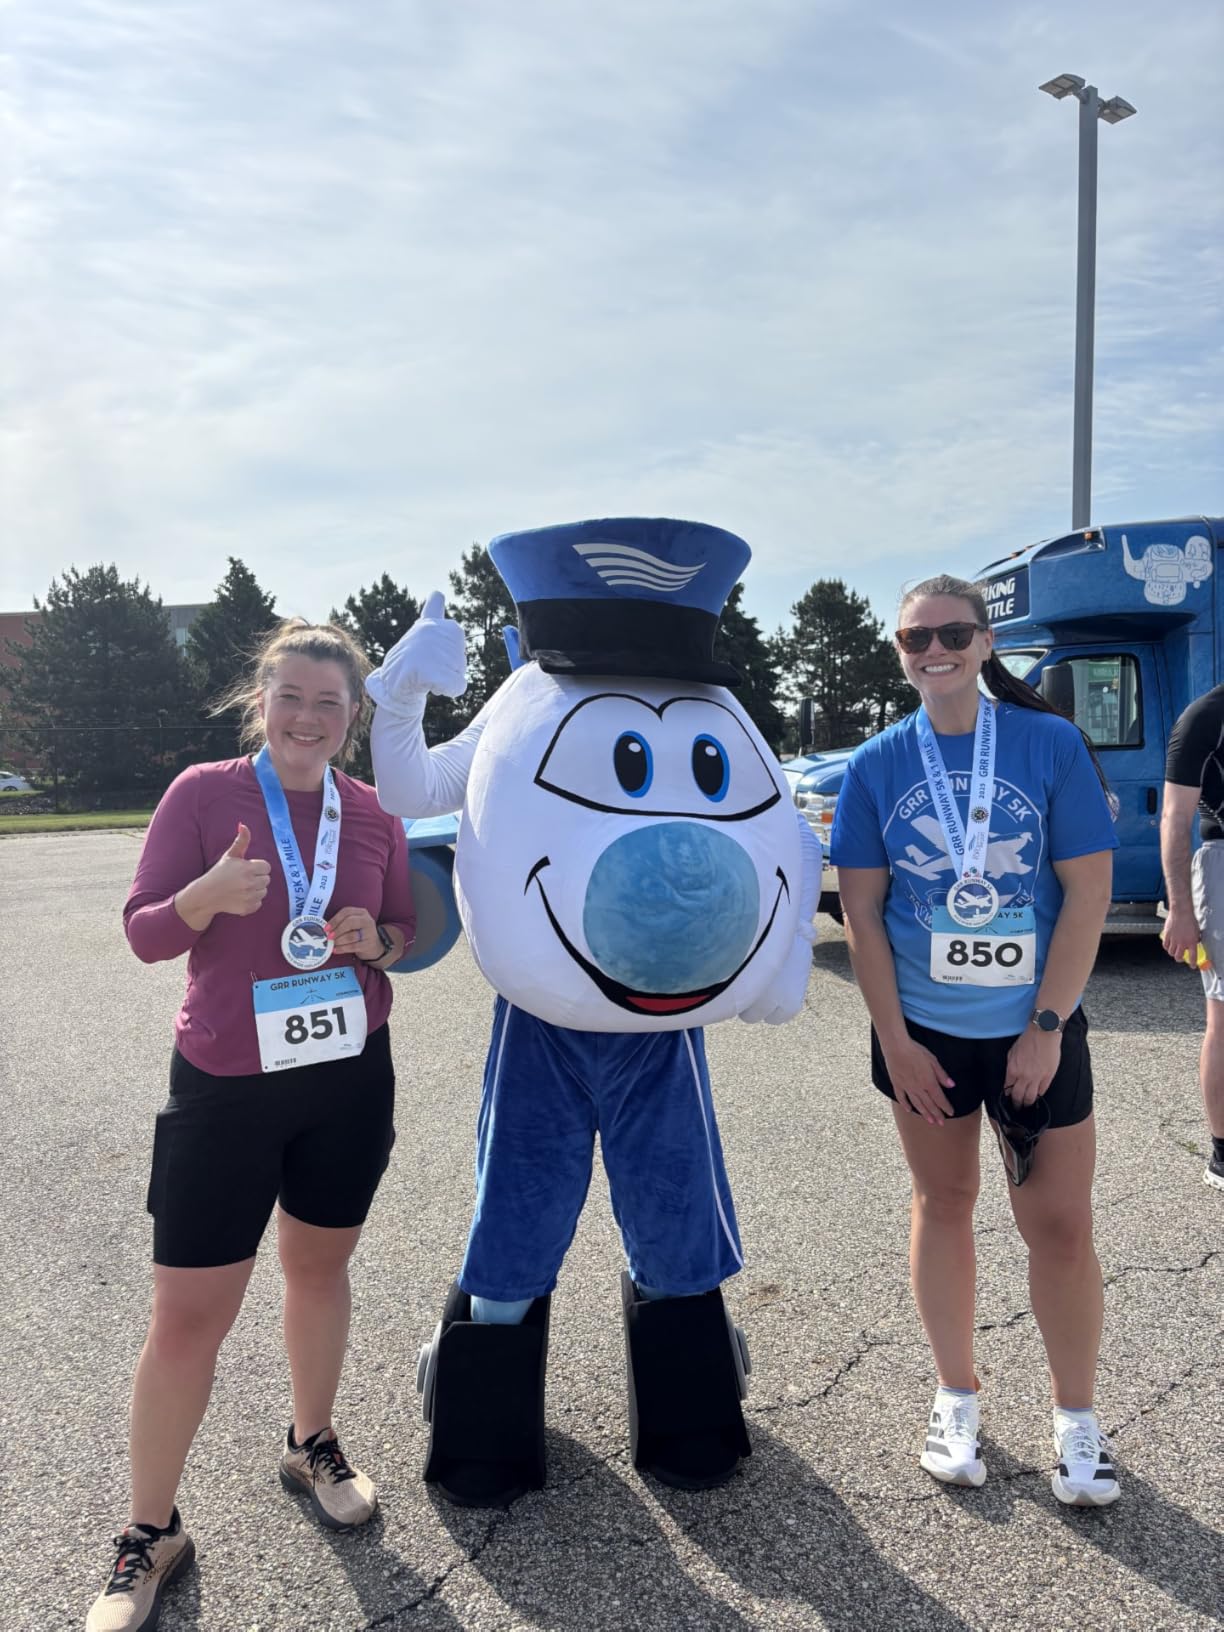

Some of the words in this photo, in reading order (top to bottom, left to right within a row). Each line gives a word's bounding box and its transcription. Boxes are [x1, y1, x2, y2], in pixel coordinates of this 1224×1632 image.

[986, 598, 1015, 619] TTLE
[980, 719, 992, 757] RUNWAY
[924, 742, 937, 763] MILE
[979, 761, 989, 777] GRR
[935, 779, 946, 791] 5K
[899, 789, 928, 820] GRR
[1007, 798, 1032, 821] 5K
[940, 794, 957, 834] RUNWAY
[281, 839, 297, 861] MILE
[952, 834, 965, 856] GRR
[290, 870, 300, 878] &
[295, 880, 304, 893] 5K
[1012, 911, 1024, 919] 5K
[946, 939, 1023, 968] 850
[270, 981, 290, 991] GRR
[291, 973, 332, 985] RUNWAY
[334, 971, 346, 980] 5K
[284, 1006, 347, 1045] 851
